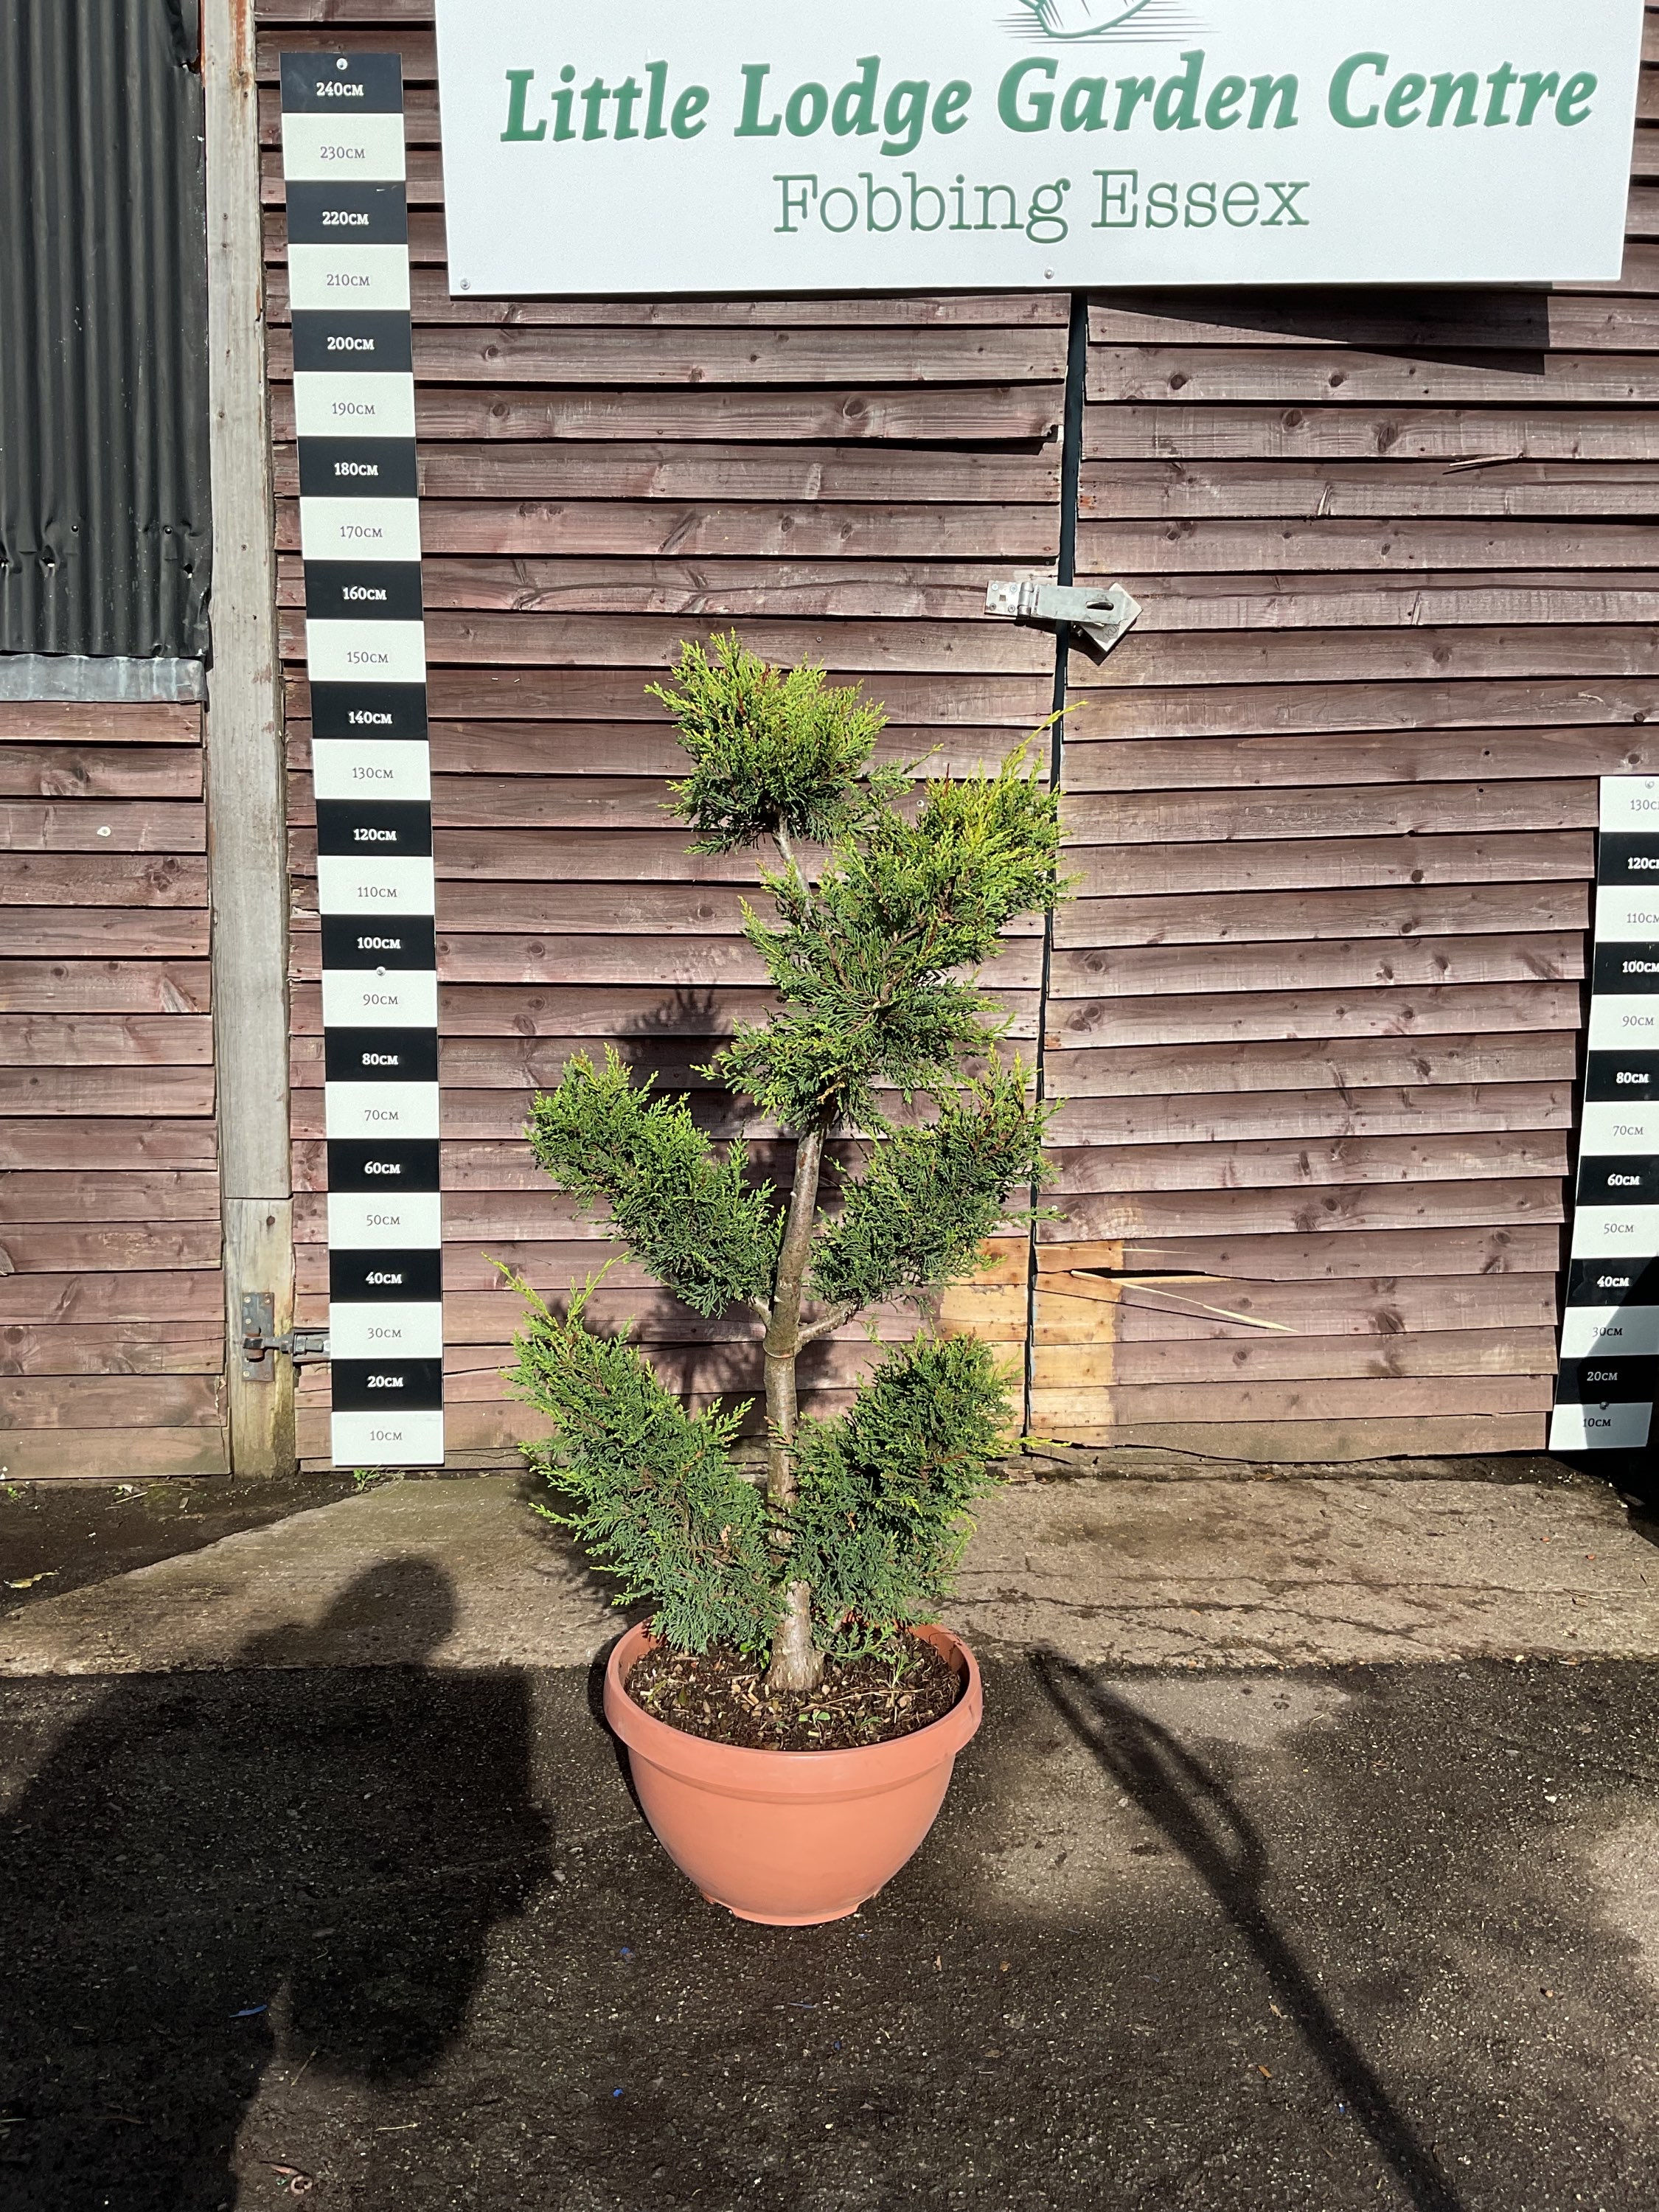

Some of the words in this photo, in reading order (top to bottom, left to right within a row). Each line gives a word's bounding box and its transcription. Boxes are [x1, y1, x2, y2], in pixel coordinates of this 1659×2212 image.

[501, 60, 709, 142] Little
[734, 55, 972, 156] Lodge
[998, 49, 1299, 132] Garden
[1329, 52, 1598, 128] Centre
[773, 172, 1071, 243] Fobbing
[1091, 169, 1310, 229] Essex
[1630, 798, 1659, 812] 130C
